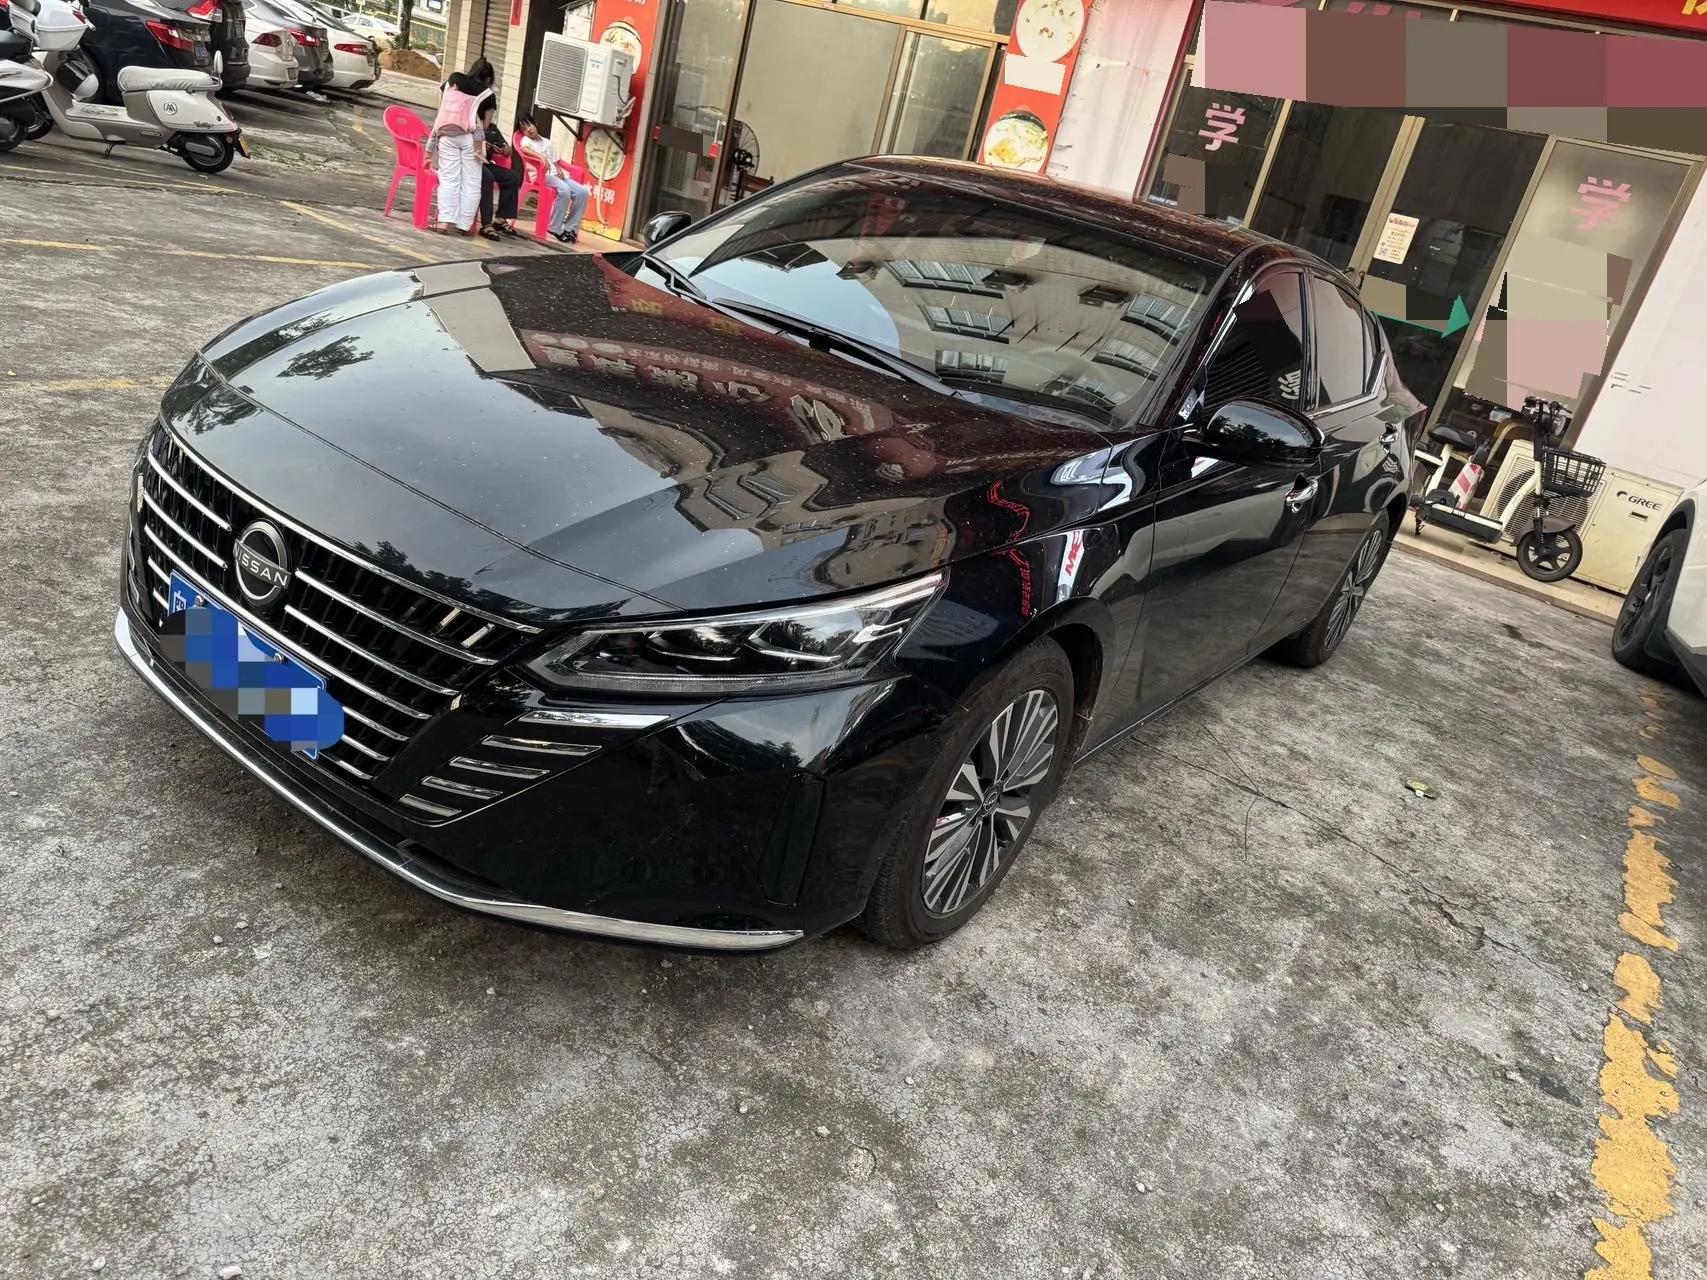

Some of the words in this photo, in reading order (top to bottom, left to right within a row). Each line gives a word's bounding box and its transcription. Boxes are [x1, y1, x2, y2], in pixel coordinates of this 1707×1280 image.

[1198, 102, 1246, 151] 学
[1568, 176, 1632, 232] 学
[1628, 495, 1662, 511] GREE
[233, 541, 288, 587] NISSAN
